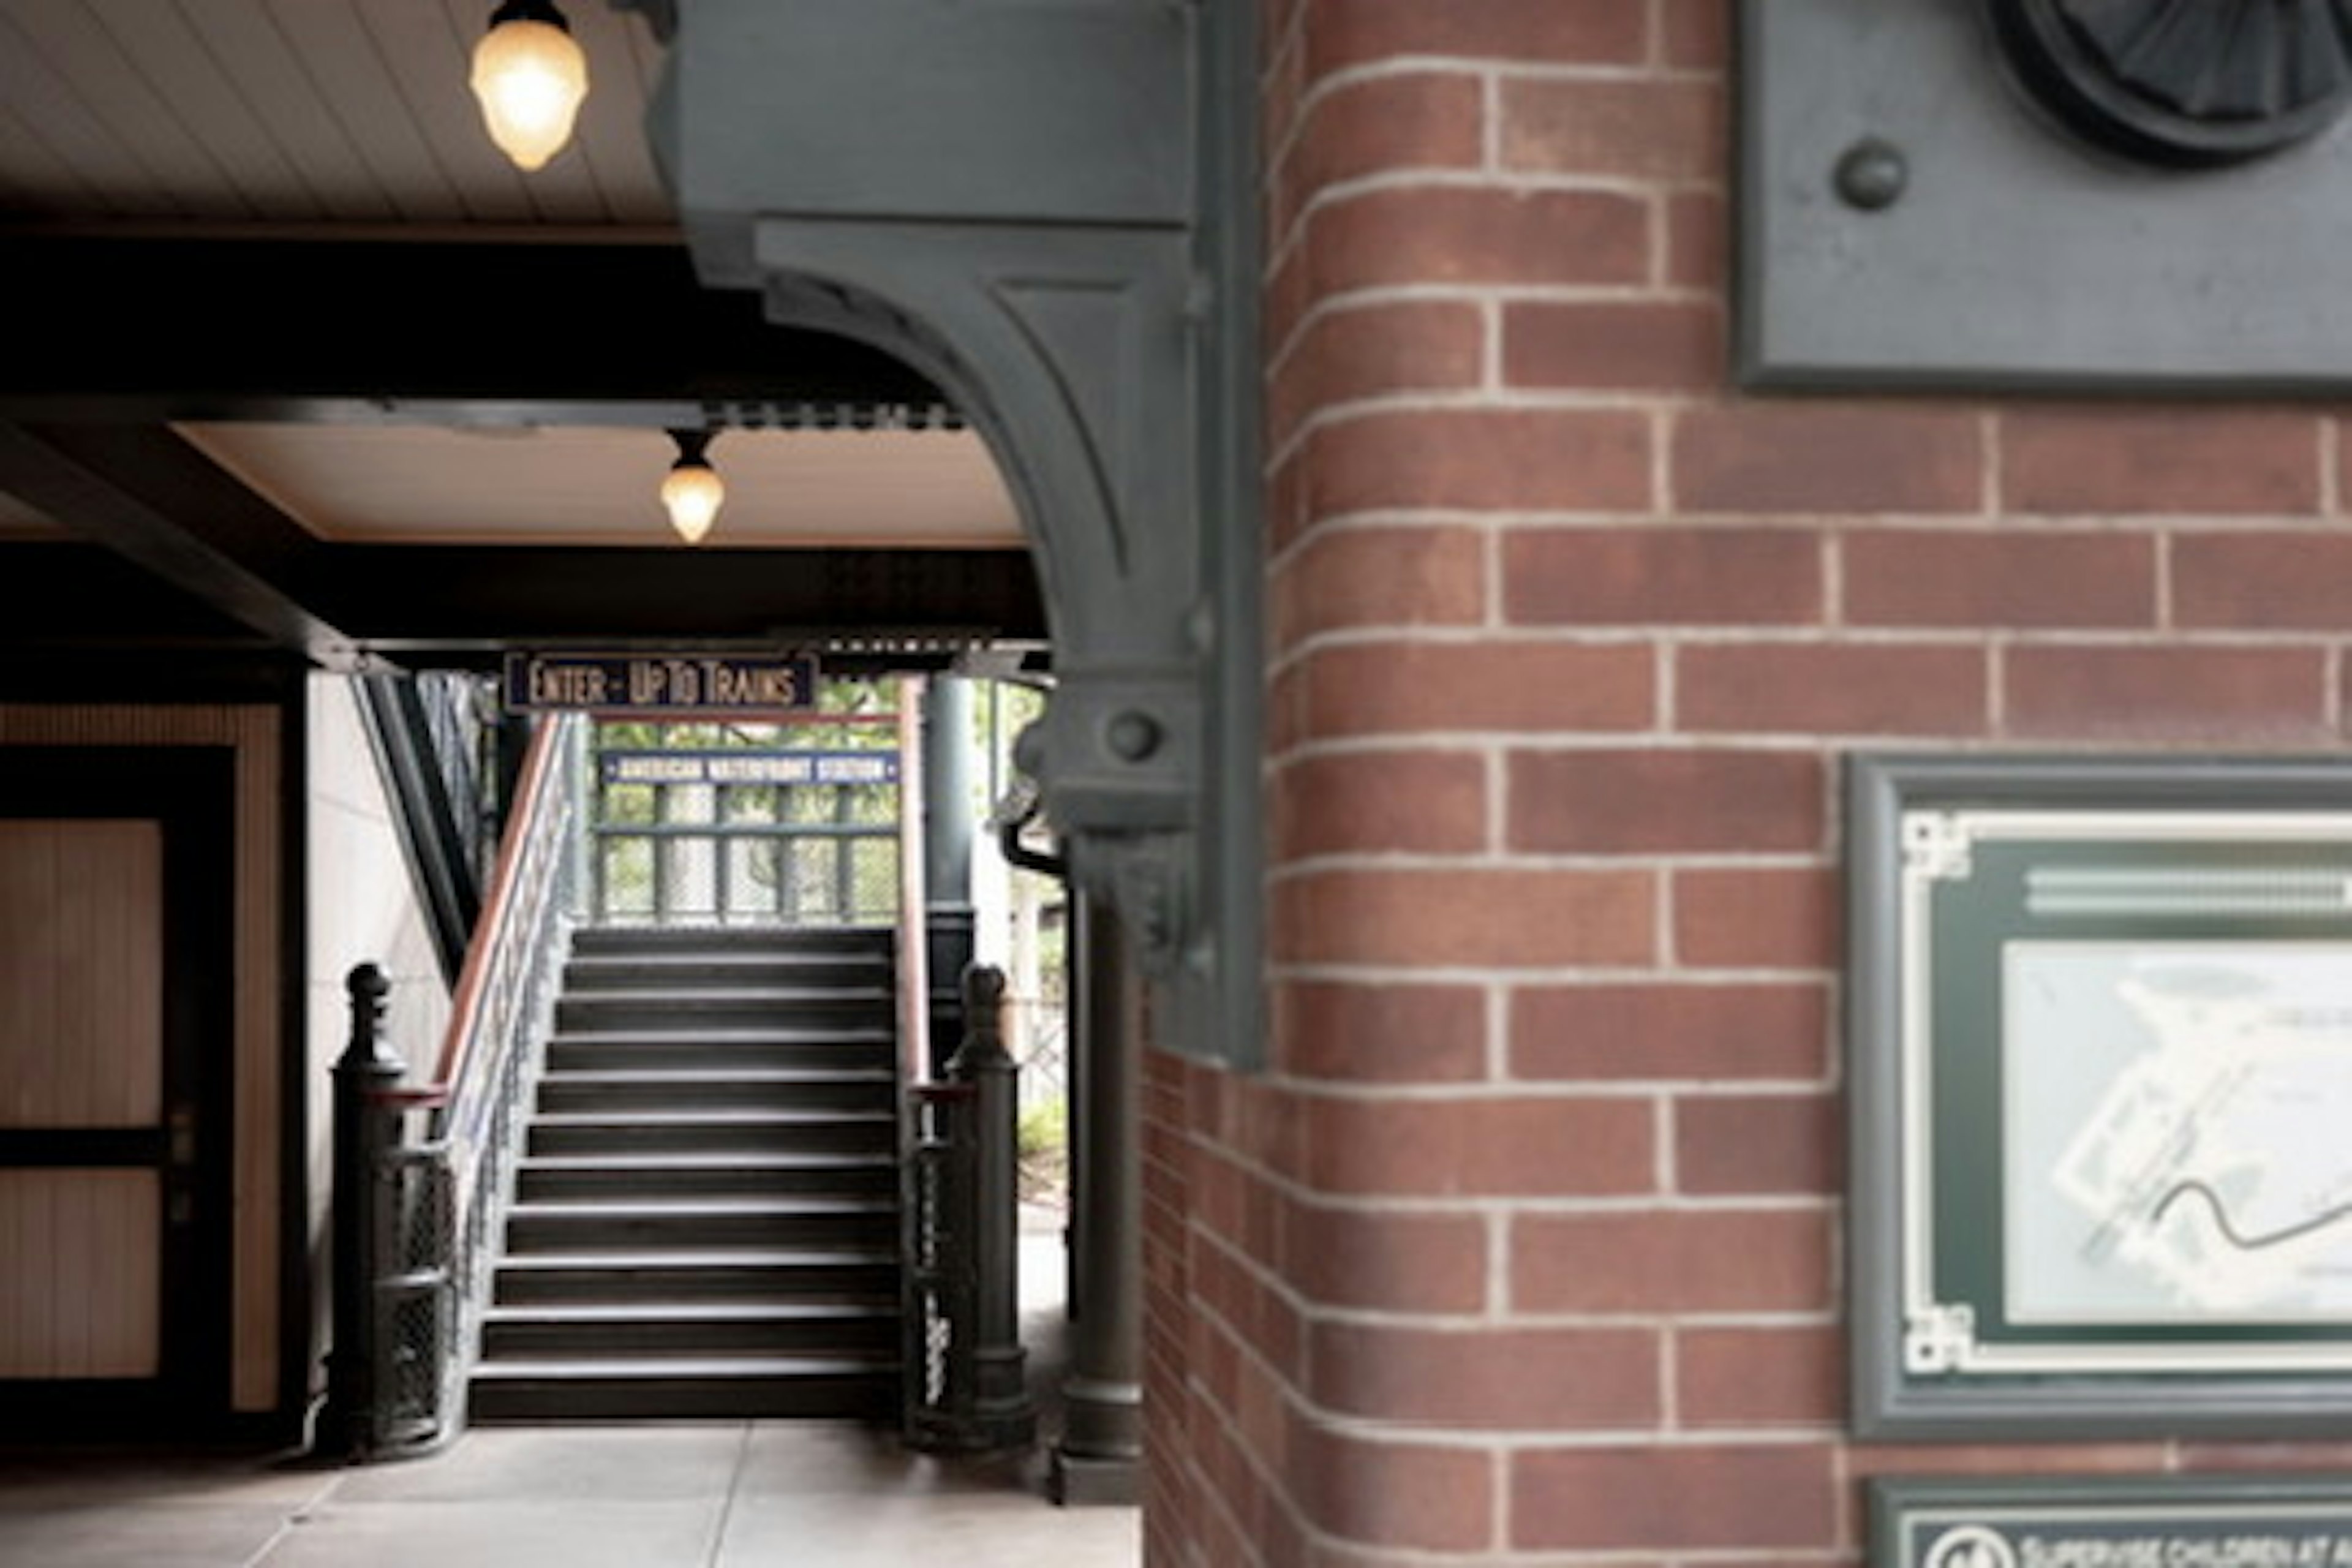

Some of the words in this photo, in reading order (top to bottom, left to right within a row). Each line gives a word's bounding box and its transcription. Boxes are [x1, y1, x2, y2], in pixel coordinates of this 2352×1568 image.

[619, 757, 703, 780] AMERICAN
[708, 757, 812, 780] WATERFRONT
[817, 757, 884, 780] STATION
[2021, 1534, 2162, 1568] SUPERVISE
[2166, 1534, 2293, 1568] CHILDREN
